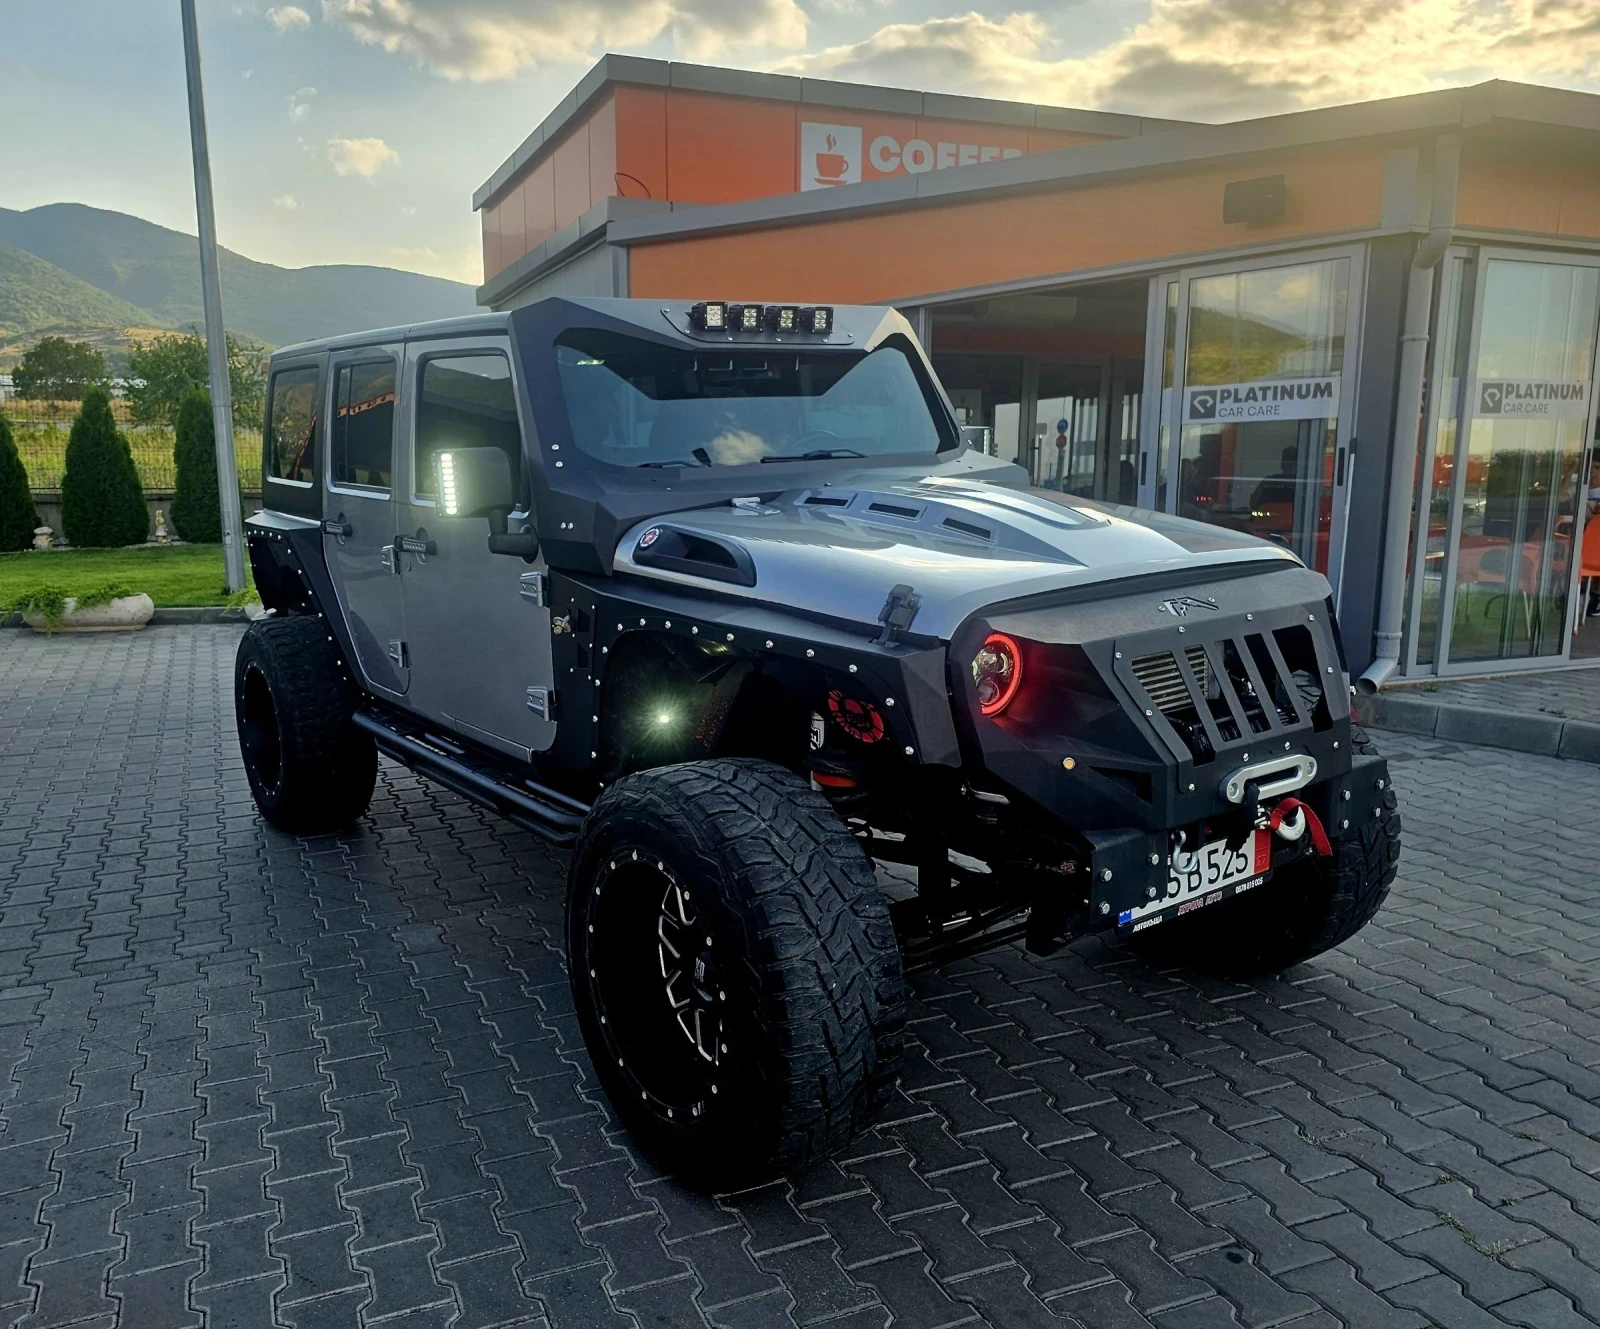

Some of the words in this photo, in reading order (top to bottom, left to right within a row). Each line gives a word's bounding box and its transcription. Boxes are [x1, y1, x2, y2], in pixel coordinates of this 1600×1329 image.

[869, 135, 1022, 174] COFF
[1219, 381, 1333, 404] PLATINUM
[1504, 383, 1584, 400] PLATINUM
[1218, 406, 1243, 418] CAR
[1247, 404, 1281, 417] CARE
[1503, 402, 1523, 413] CAR
[1525, 402, 1549, 414] CARE
